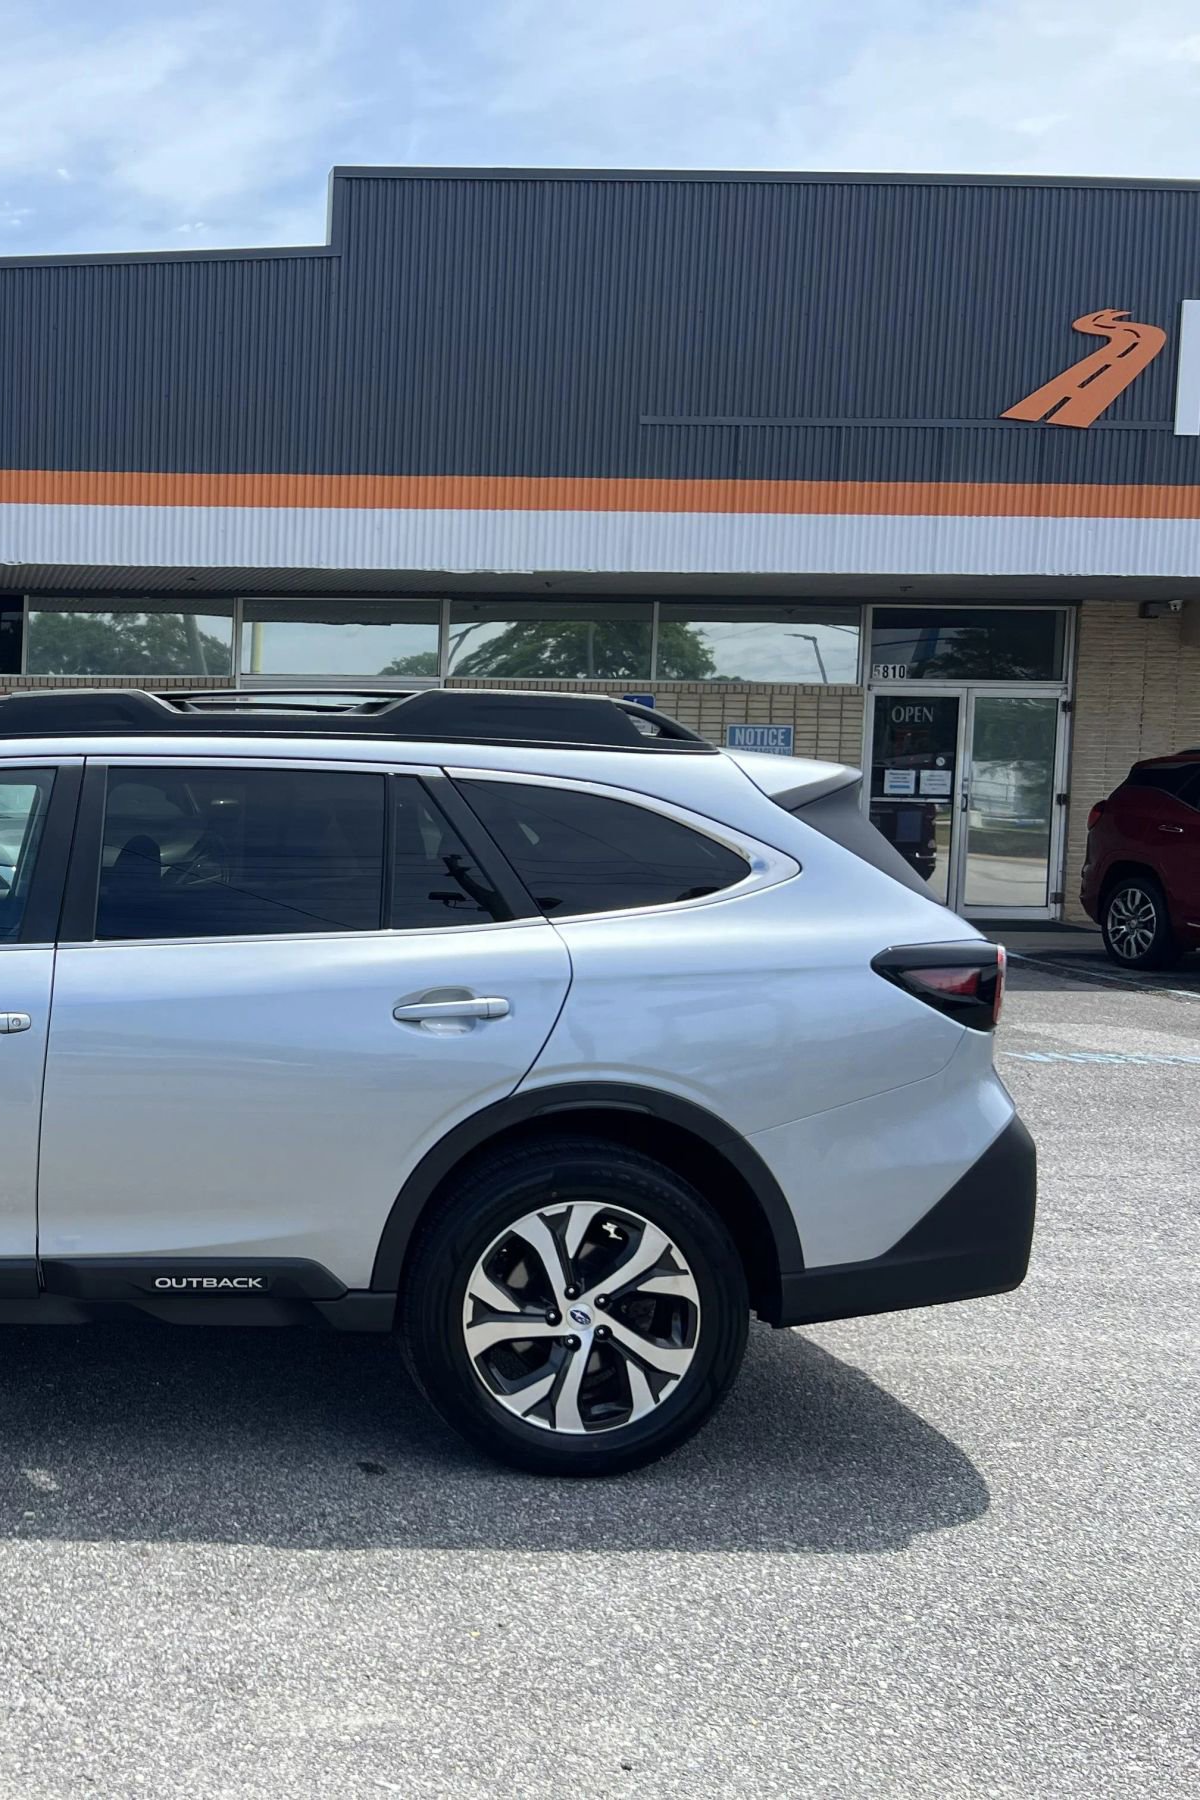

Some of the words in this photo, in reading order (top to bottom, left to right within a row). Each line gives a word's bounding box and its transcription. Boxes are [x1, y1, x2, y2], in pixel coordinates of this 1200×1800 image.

[873, 665, 906, 679] 5810
[891, 706, 934, 723] OPEN
[735, 728, 786, 746] NOTICE
[154, 1277, 263, 1289] OUTBACK
